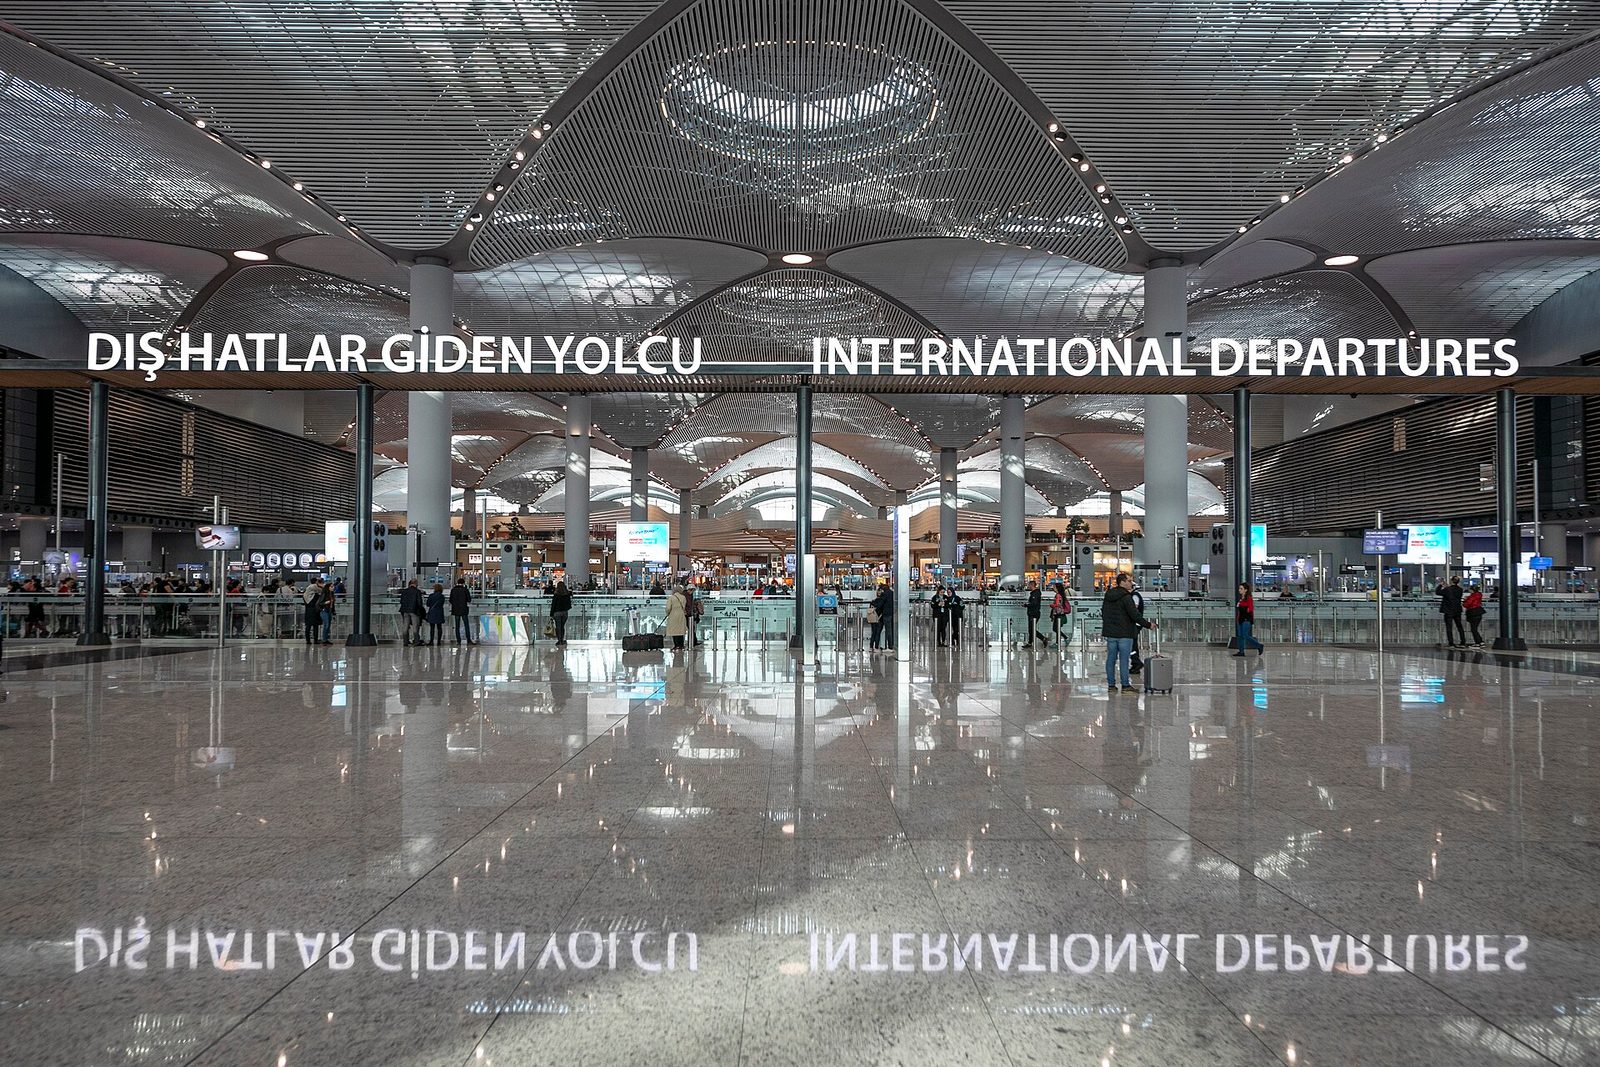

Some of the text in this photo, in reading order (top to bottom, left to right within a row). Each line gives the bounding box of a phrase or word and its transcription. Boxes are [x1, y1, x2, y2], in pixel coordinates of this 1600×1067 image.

[87, 325, 702, 382] DIŞ HATLAR GİDEN YOLCU
[812, 338, 1519, 377] INTERNATIONAL DEPARTURES
